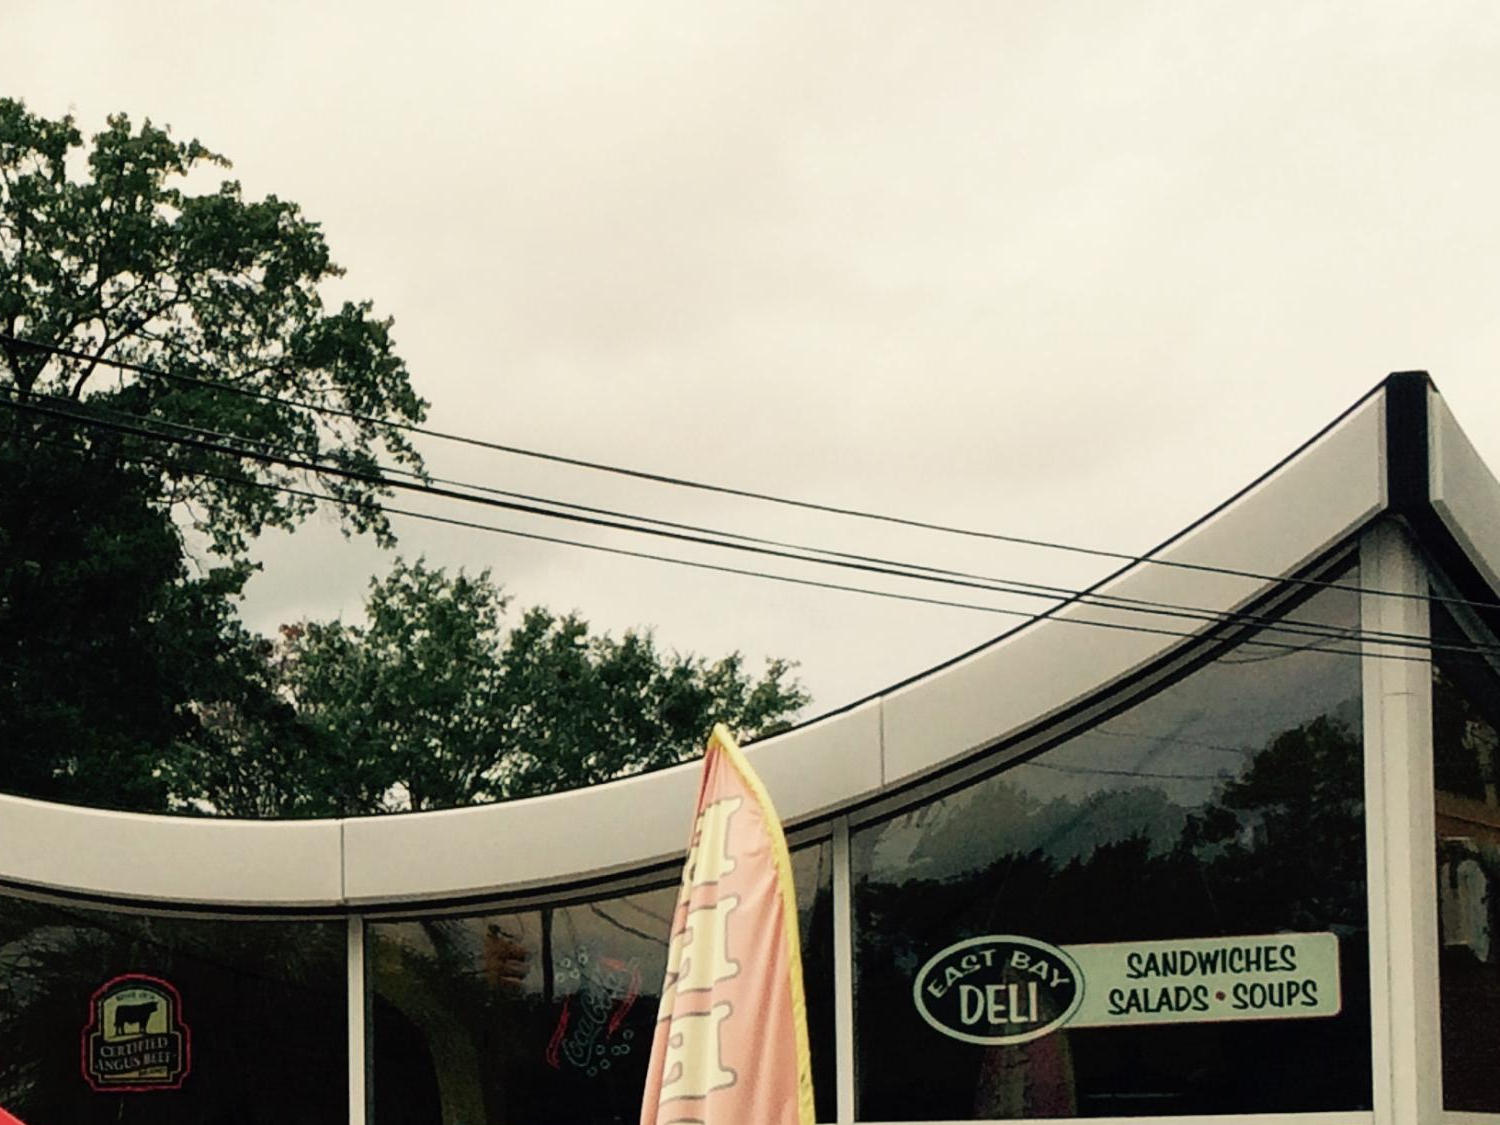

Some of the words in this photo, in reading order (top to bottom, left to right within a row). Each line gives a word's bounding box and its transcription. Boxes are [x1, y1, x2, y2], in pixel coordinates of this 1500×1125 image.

[927, 949, 997, 998] EAST
[1010, 951, 1070, 989] BAY
[1126, 945, 1297, 979] SANDWICHES
[959, 982, 1038, 1025] DELI
[1108, 984, 1209, 1015] SALADS
[1232, 980, 1318, 1009] SOUPS
[97, 1056, 141, 1071] ANGUS
[100, 1037, 168, 1057] CERTIFIED
